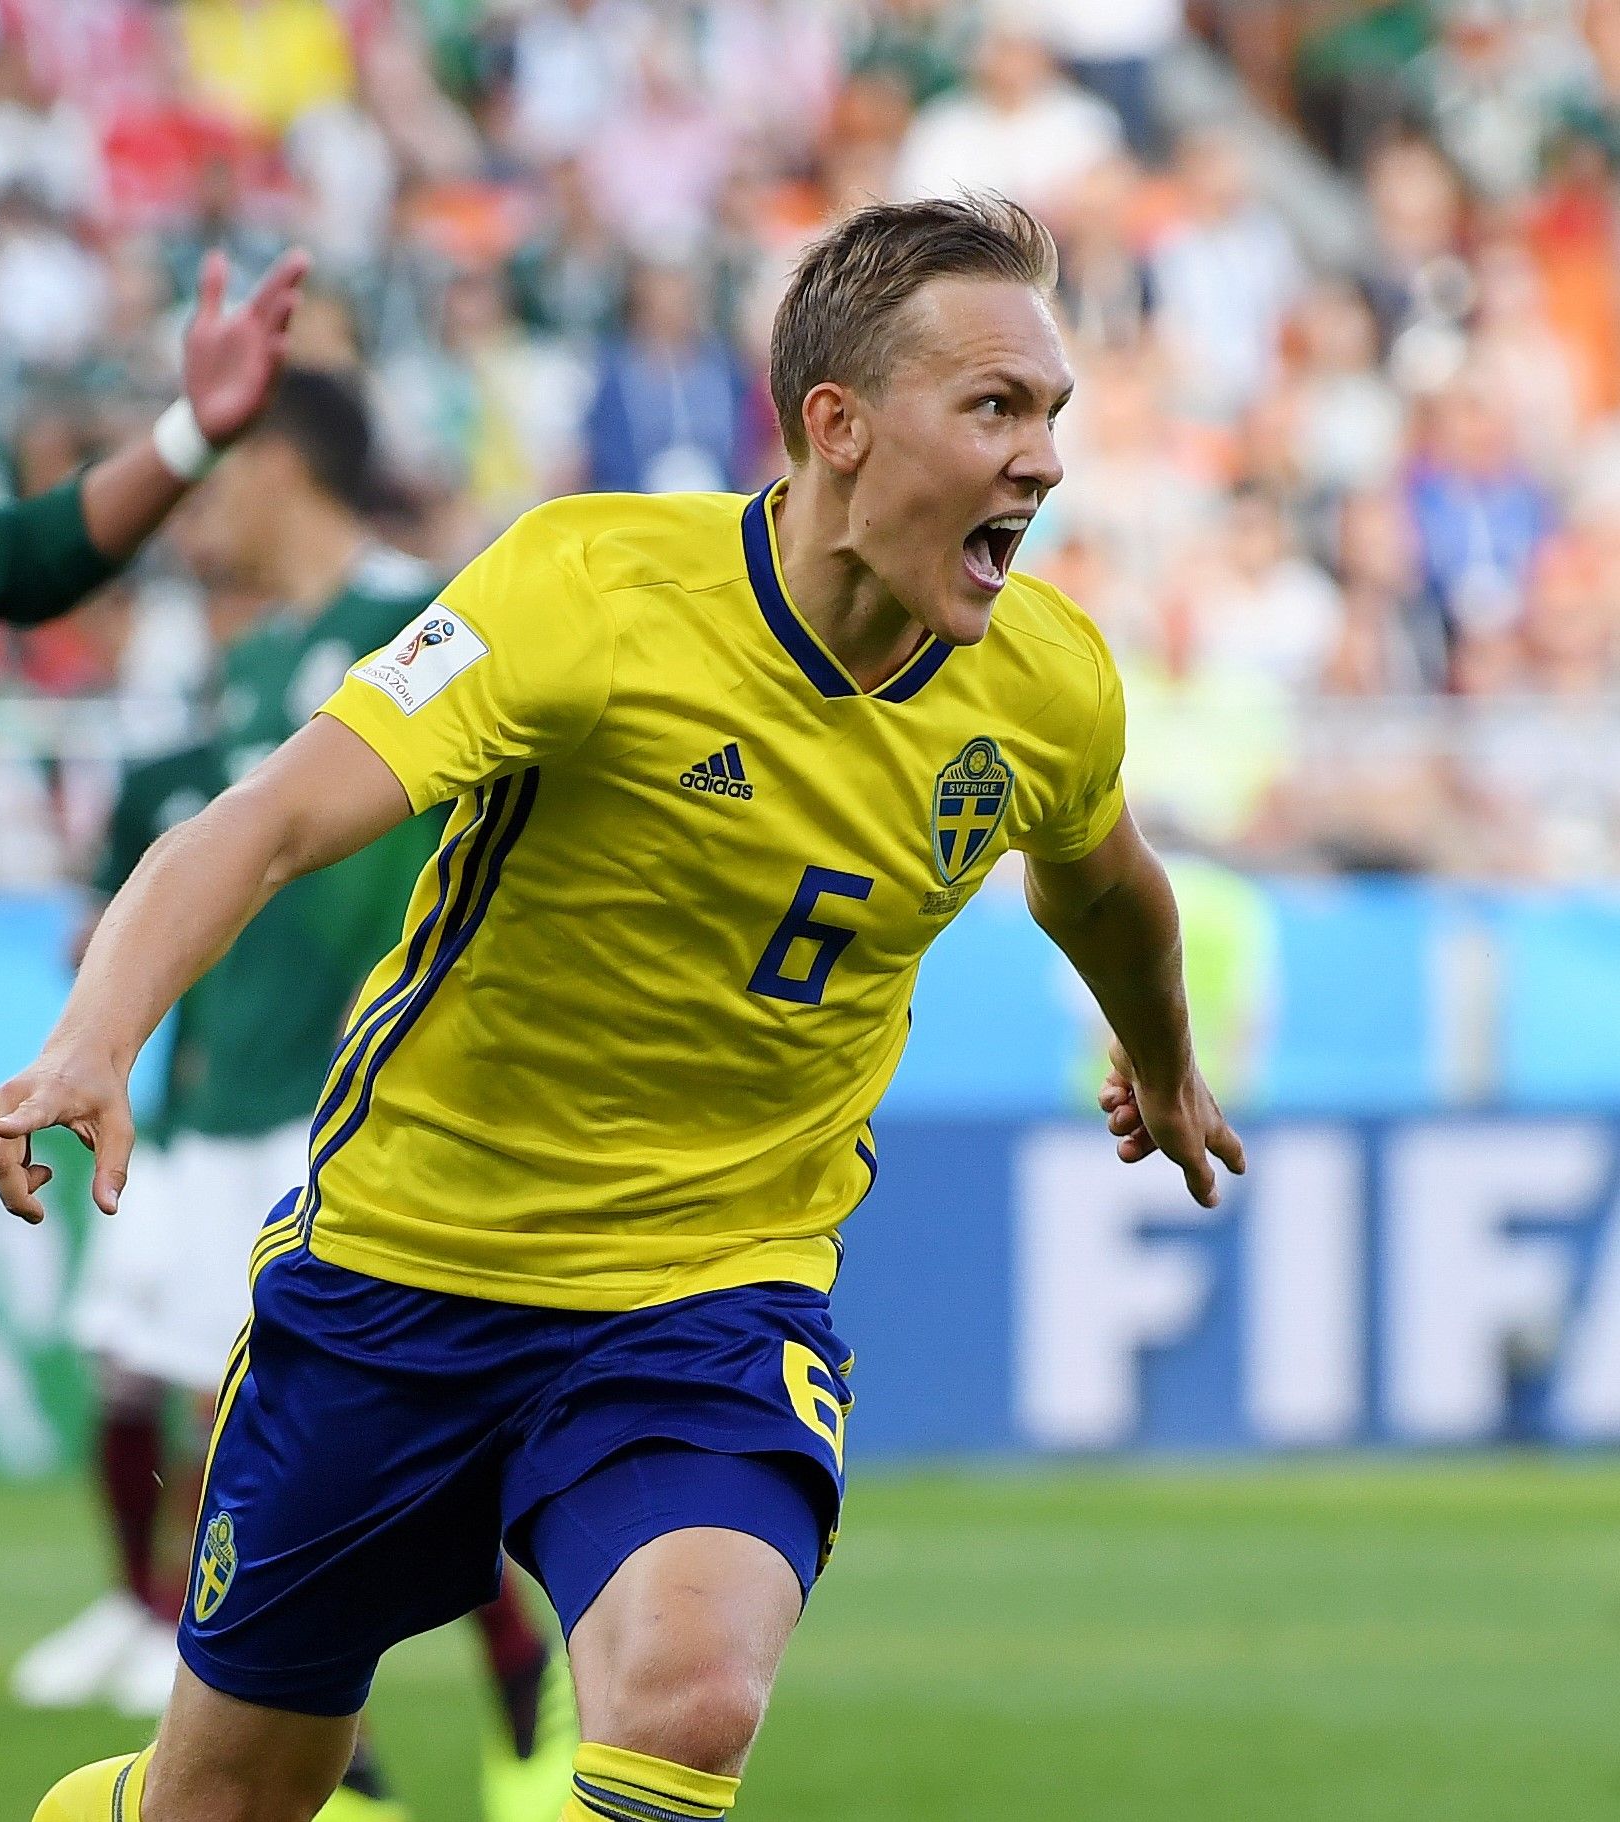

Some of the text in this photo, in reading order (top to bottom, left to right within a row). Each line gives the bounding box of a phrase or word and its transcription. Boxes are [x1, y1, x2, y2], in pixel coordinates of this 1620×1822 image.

[389, 677, 415, 707] 2018
[680, 772, 754, 801] adidas
[948, 783, 997, 795] SVERIGE
[746, 865, 875, 1006] 6
[782, 1339, 845, 1478] 6
